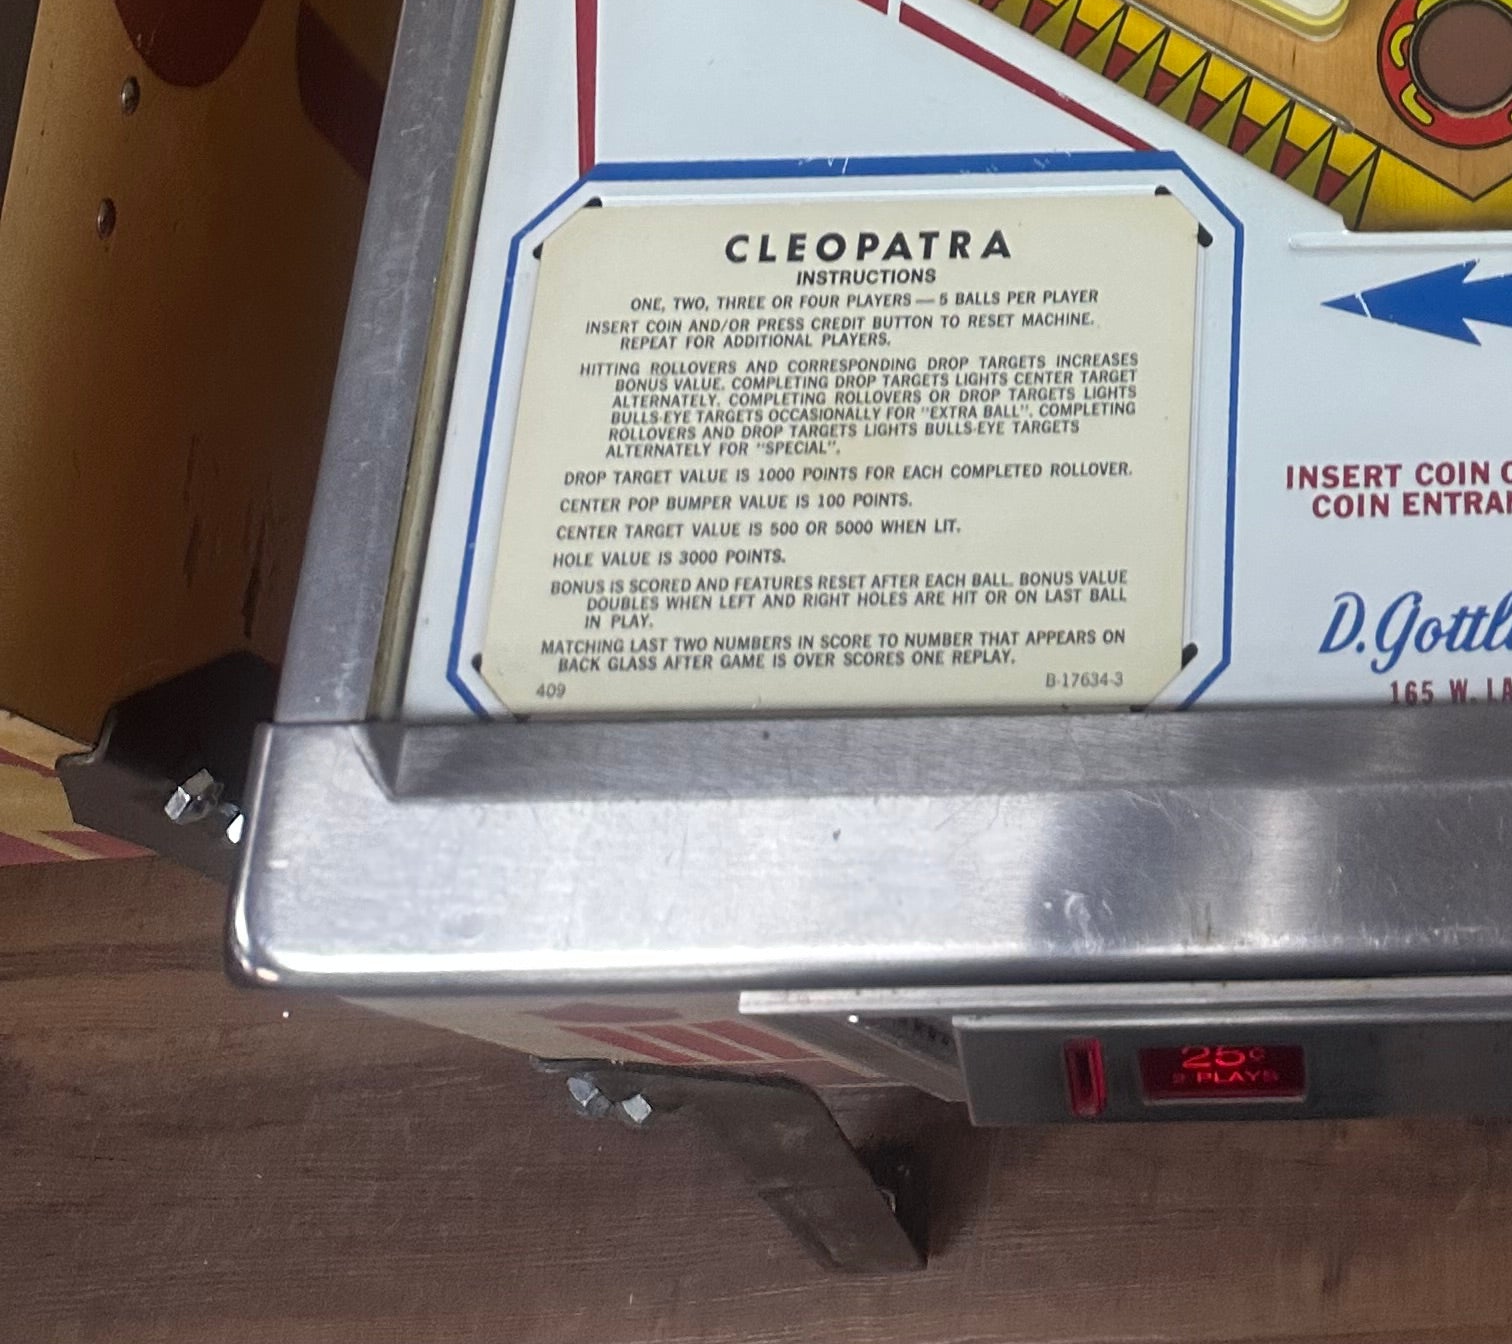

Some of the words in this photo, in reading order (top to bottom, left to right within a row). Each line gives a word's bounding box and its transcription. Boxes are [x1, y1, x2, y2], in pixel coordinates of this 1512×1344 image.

[724, 229, 1012, 264] CLEOPATRA
[796, 268, 937, 287] INSTRUCTIONS
[1286, 463, 1402, 490] INSERT
[1415, 460, 1490, 487] COIN
[1312, 492, 1389, 519] COIN
[553, 552, 593, 568] HOLE
[601, 551, 650, 567] VALUE
[658, 551, 672, 565] IS
[679, 550, 718, 565] 3000
[725, 548, 786, 564] POINTS.
[536, 682, 566, 698] 409
[1389, 680, 1435, 706] 165
[1448, 678, 1478, 705] W.
[1196, 1069, 1279, 1084] PLAYS
